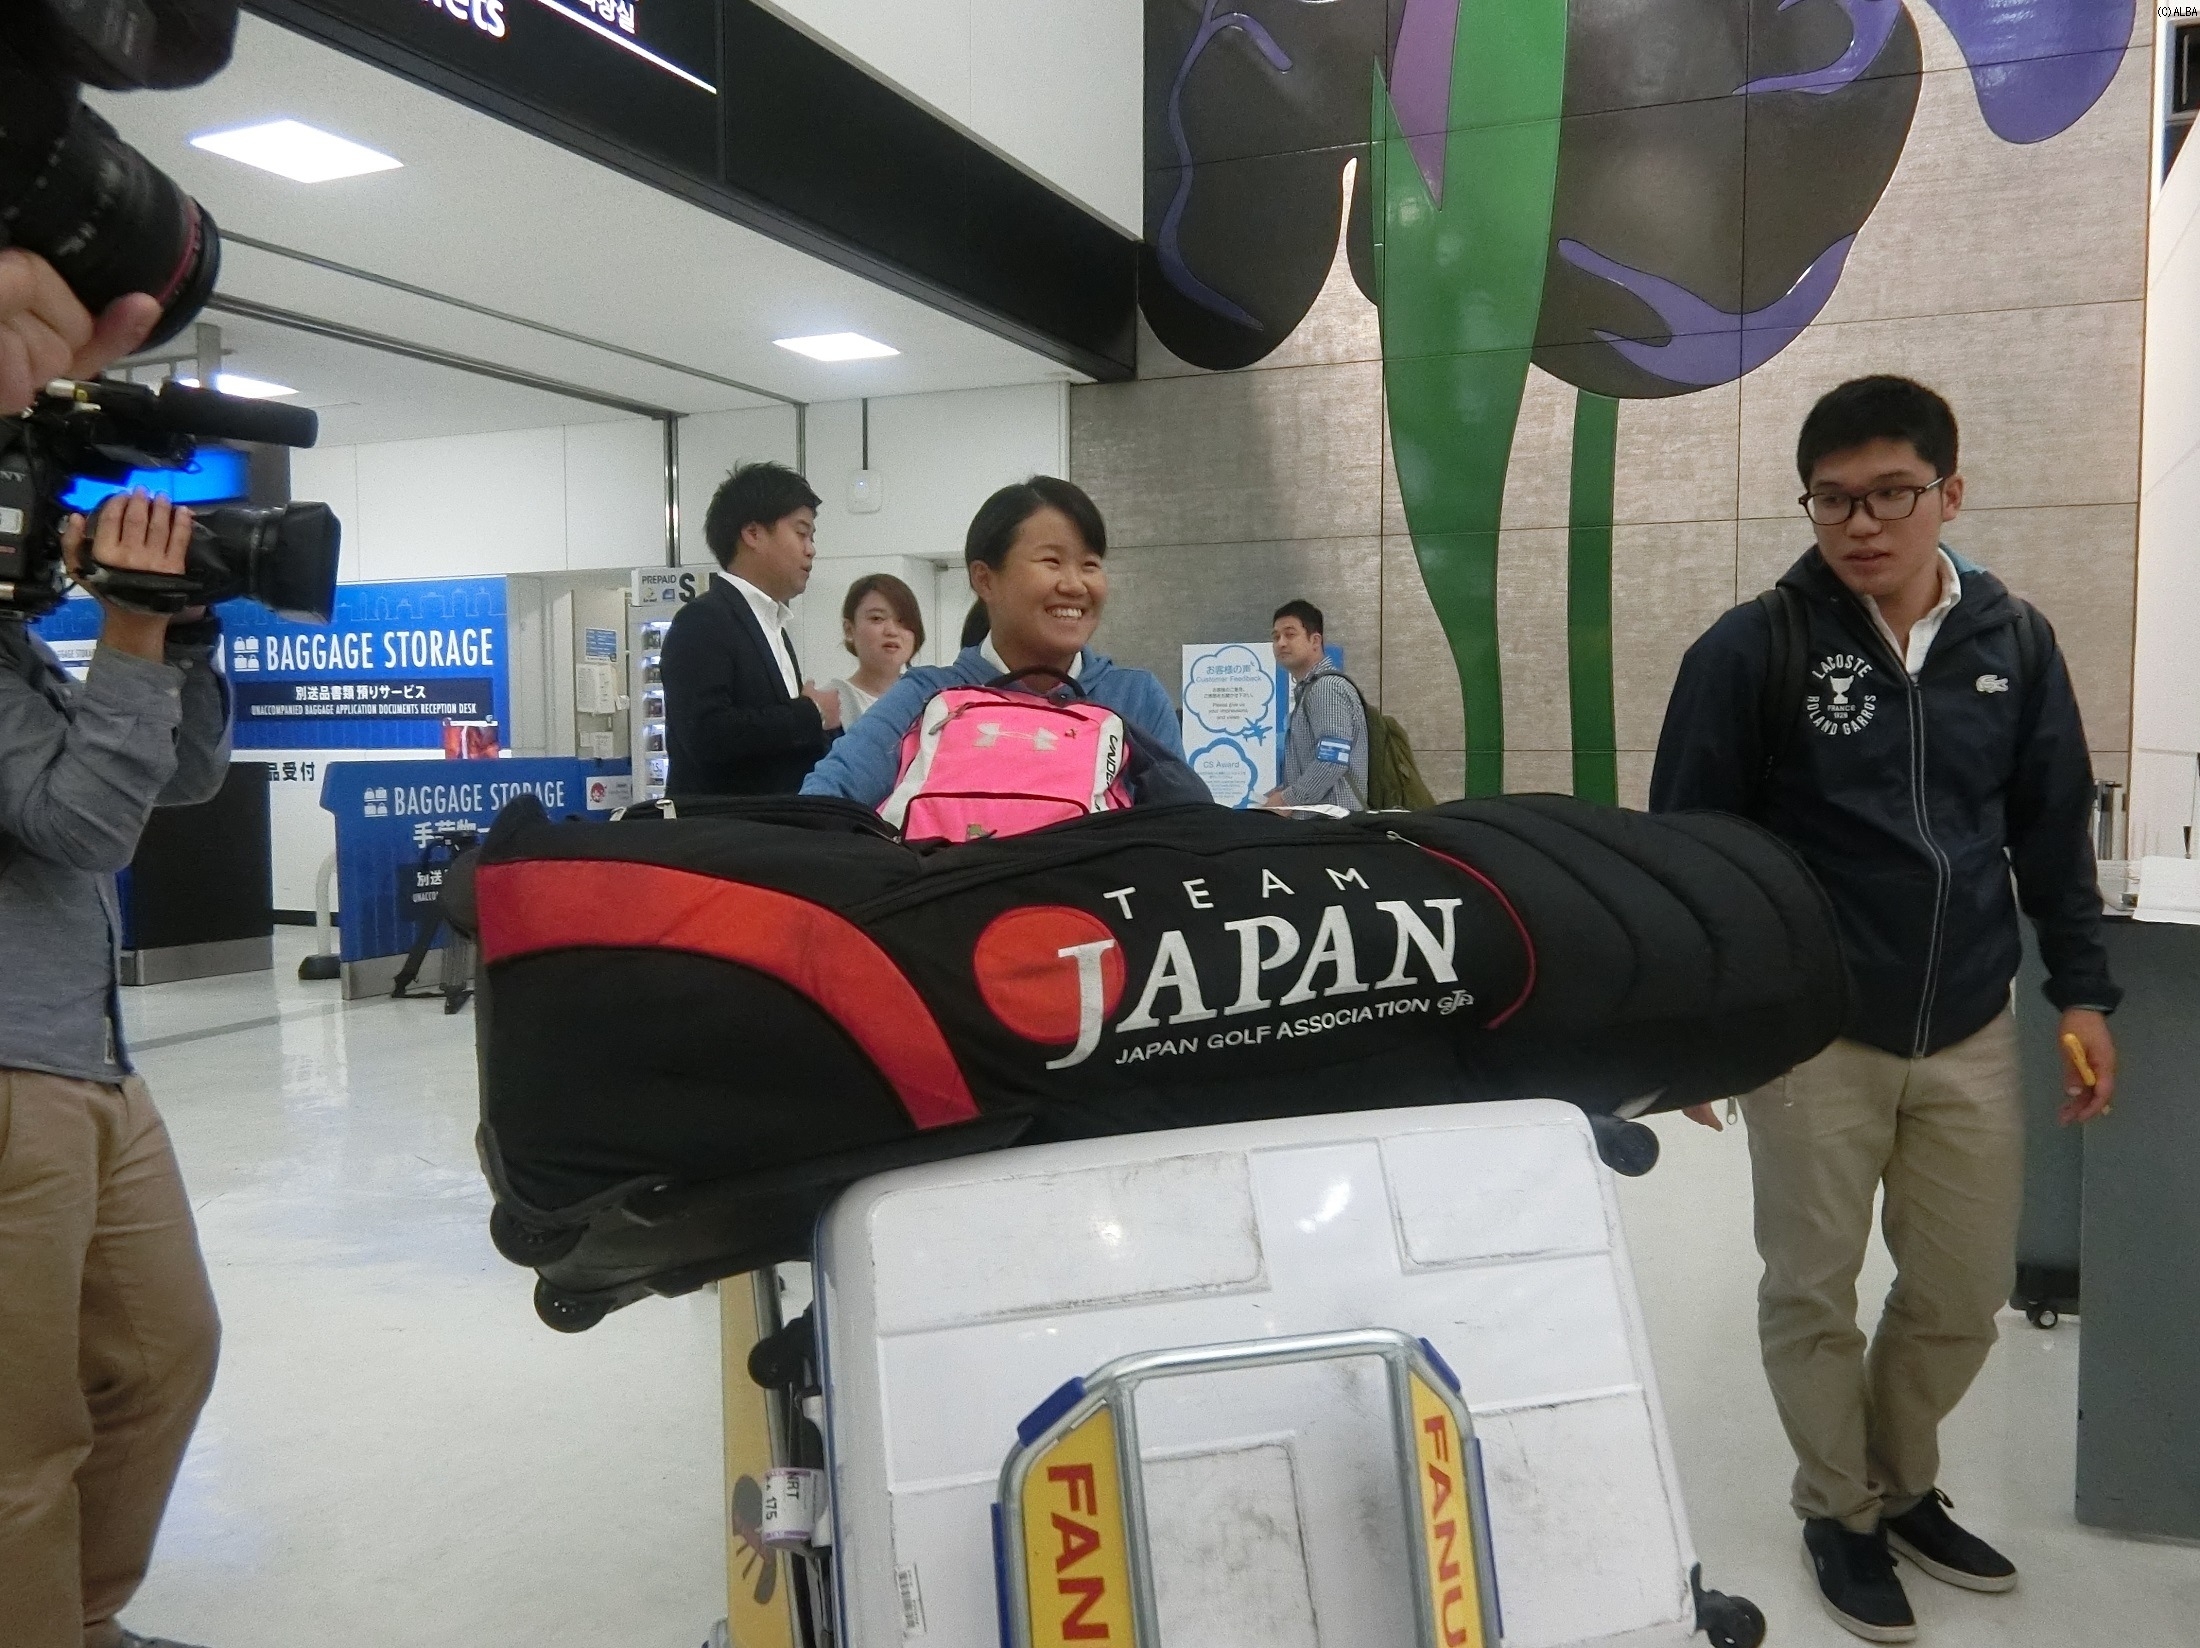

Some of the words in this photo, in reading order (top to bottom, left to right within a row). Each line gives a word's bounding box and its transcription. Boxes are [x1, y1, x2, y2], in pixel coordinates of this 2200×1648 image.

[641, 574, 677, 585] PREPAID
[266, 632, 374, 672] BAGGAGE
[383, 627, 494, 670] STORAGE
[1811, 653, 1873, 680] LACOSTE
[1206, 664, 1252, 675] お客様の声
[251, 704, 304, 716] UNACCOMPANIED
[304, 704, 335, 715] BAGGAGE
[335, 703, 377, 715] APPLICATION
[378, 703, 419, 715] DOCUMENTS
[420, 702, 457, 714] RECEPTION
[458, 702, 477, 714] DESK
[295, 685, 355, 701] 別送品書類
[356, 684, 427, 700] 預りサービス
[1826, 704, 1857, 712] FRANCE
[1806, 695, 1839, 736] ROLAND
[1841, 694, 1877, 736] GARROS
[1106, 734, 1119, 788] UNDE
[1203, 761, 1214, 769] CS
[1215, 760, 1240, 769] Award
[394, 783, 483, 816] BAGGAGE
[1102, 867, 1371, 921] TEAM
[1044, 897, 1464, 1071] JAPAN
[1114, 1037, 1199, 1066] JAPAN
[1206, 1025, 1272, 1049] GOLF
[1275, 998, 1431, 1040] ASSOCIATION
[1422, 1414, 1467, 1648] FANU
[1046, 1462, 1111, 1641] FAN
